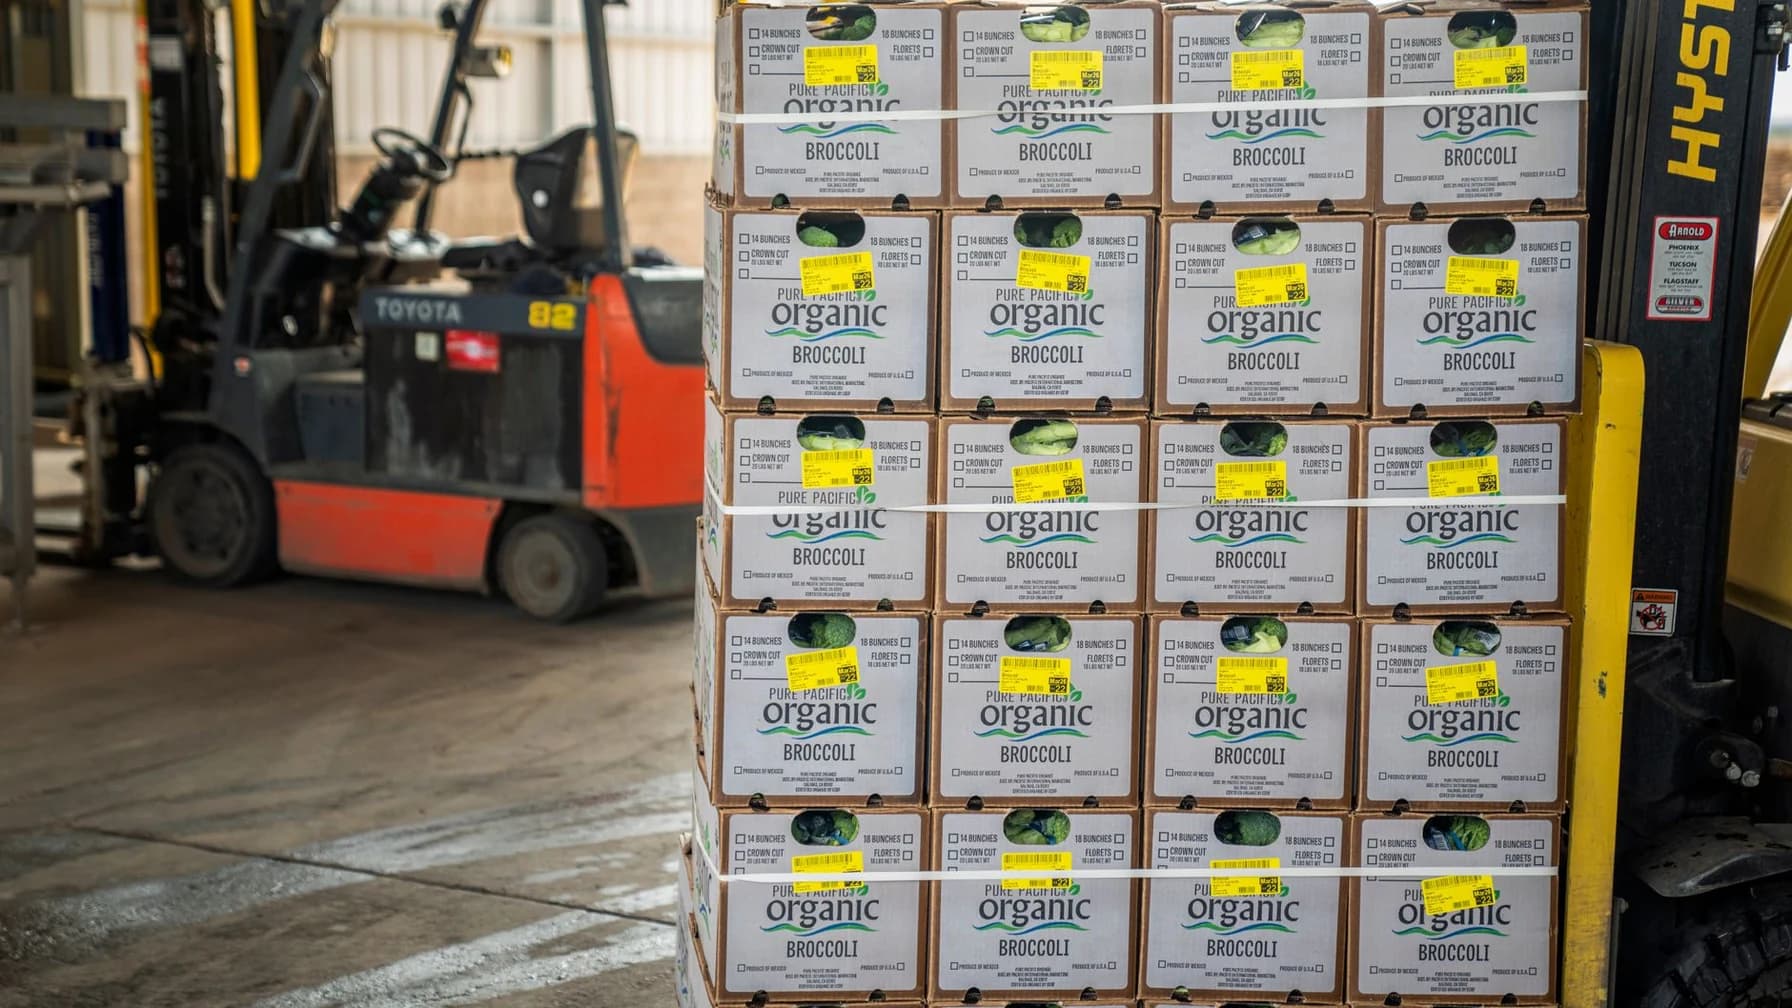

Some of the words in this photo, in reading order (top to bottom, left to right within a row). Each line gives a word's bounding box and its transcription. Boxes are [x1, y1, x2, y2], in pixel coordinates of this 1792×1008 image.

[761, 29, 769, 38] 14
[770, 29, 801, 39] BUNCHES
[1103, 29, 1134, 40] BUNCHES
[1530, 33, 1561, 44] BUNCHES
[1191, 37, 1199, 46] 14
[1200, 36, 1230, 46] BUNCHES
[761, 44, 786, 54] CROWN
[787, 44, 800, 53] CUT
[1106, 44, 1134, 55] FLORETS
[1533, 47, 1561, 58] FLORETS
[1191, 51, 1215, 61] CROWN
[1216, 51, 1229, 61] CUT
[1218, 89, 1247, 103] PURE
[1423, 100, 1539, 138] organic
[805, 140, 880, 161] BROCCOLI
[1019, 141, 1092, 162] BROCCOLI
[1233, 145, 1306, 167] BROCCOLI
[1444, 144, 1517, 168] BROCCOLI
[1669, 224, 1705, 237] ARNOLD
[878, 237, 909, 246] BUNCHES
[970, 236, 977, 245] 14
[978, 236, 1008, 245] BUNCHES
[1313, 243, 1343, 253] BUNCHES
[1404, 245, 1411, 255] 14
[1412, 244, 1442, 255] BUNCHES
[881, 252, 909, 261] FLORETS
[969, 251, 994, 260] CROWN
[994, 251, 1007, 260] CUT
[1316, 257, 1343, 267] FLORETS
[1403, 259, 1427, 269] CROWN
[1428, 259, 1441, 268] CUT
[996, 288, 1025, 302] PURE
[1429, 295, 1458, 310] PURE
[375, 298, 462, 323] TOYOTA
[528, 301, 577, 330] 82
[772, 303, 887, 333] organic
[990, 302, 1105, 334] organic
[1208, 308, 1322, 341] organic
[1423, 307, 1537, 342] organic
[793, 345, 866, 364] BROCCOLI
[1011, 344, 1084, 364] BROCCOLI
[1228, 351, 1300, 371] BROCCOLI
[1444, 350, 1516, 372] BROCCOLI
[752, 439, 760, 448] 14
[761, 439, 791, 448] BUNCHES
[1090, 444, 1120, 454] BUNCHES
[1177, 444, 1184, 453] 14
[1185, 444, 1215, 453] BUNCHES
[1510, 443, 1540, 454] BUNCHES
[752, 454, 776, 463] CROWN
[777, 454, 790, 463] CUT
[1093, 458, 1120, 468] FLORETS
[1176, 458, 1200, 467] CROWN
[1200, 459, 1213, 467] CUT
[1513, 457, 1540, 467] FLORETS
[778, 491, 807, 504] PURE
[1195, 508, 1309, 540] organic
[1406, 507, 1519, 542] organic
[793, 547, 865, 566] BROCCOLI
[1006, 550, 1078, 569] BROCCOLI
[1215, 550, 1287, 569] BROCCOLI
[1427, 549, 1498, 571] BROCCOLI
[869, 637, 899, 647] BUNCHES
[961, 640, 968, 649] 14
[969, 639, 999, 649] BUNCHES
[1300, 643, 1330, 652] BUNCHES
[1389, 644, 1397, 653] 14
[1398, 644, 1428, 653] BUNCHES
[871, 652, 898, 661] FLORETS
[960, 654, 984, 663] CROWN
[985, 654, 998, 663] CUT
[1302, 657, 1329, 666] FLORETS
[1389, 658, 1413, 667] CROWN
[1413, 659, 1426, 667] CUT
[769, 687, 798, 700] PURE
[1201, 691, 1230, 704] PURE
[763, 701, 877, 732] organic
[980, 703, 1093, 734] organic
[1195, 706, 1308, 735] organic
[1408, 708, 1521, 739] organic
[784, 742, 856, 762] BROCCOLI
[1000, 744, 1072, 764] BROCCOLI
[1214, 746, 1286, 765] BROCCOLI
[1428, 749, 1499, 768] BROCCOLI
[747, 835, 755, 843] 14
[755, 834, 786, 844] BUNCHES
[1083, 834, 1112, 843] BUNCHES
[1170, 833, 1178, 842] 14
[1179, 833, 1208, 842] BUNCHES
[1502, 840, 1532, 849] BUNCHES
[747, 848, 771, 858] CROWN
[771, 849, 784, 857] CUT
[1085, 848, 1112, 857] FLORETS
[1170, 847, 1193, 856] CROWN
[1194, 848, 1207, 856] CUT
[1505, 854, 1532, 863] FLORETS
[766, 897, 880, 930] organic
[979, 897, 1091, 928] organic
[1187, 898, 1300, 928] organic
[786, 939, 858, 959] BROCCOLI
[999, 938, 1070, 957] BROCCOLI
[1207, 938, 1278, 958] BROCCOLI
[1418, 943, 1490, 962] BROCCOLI
